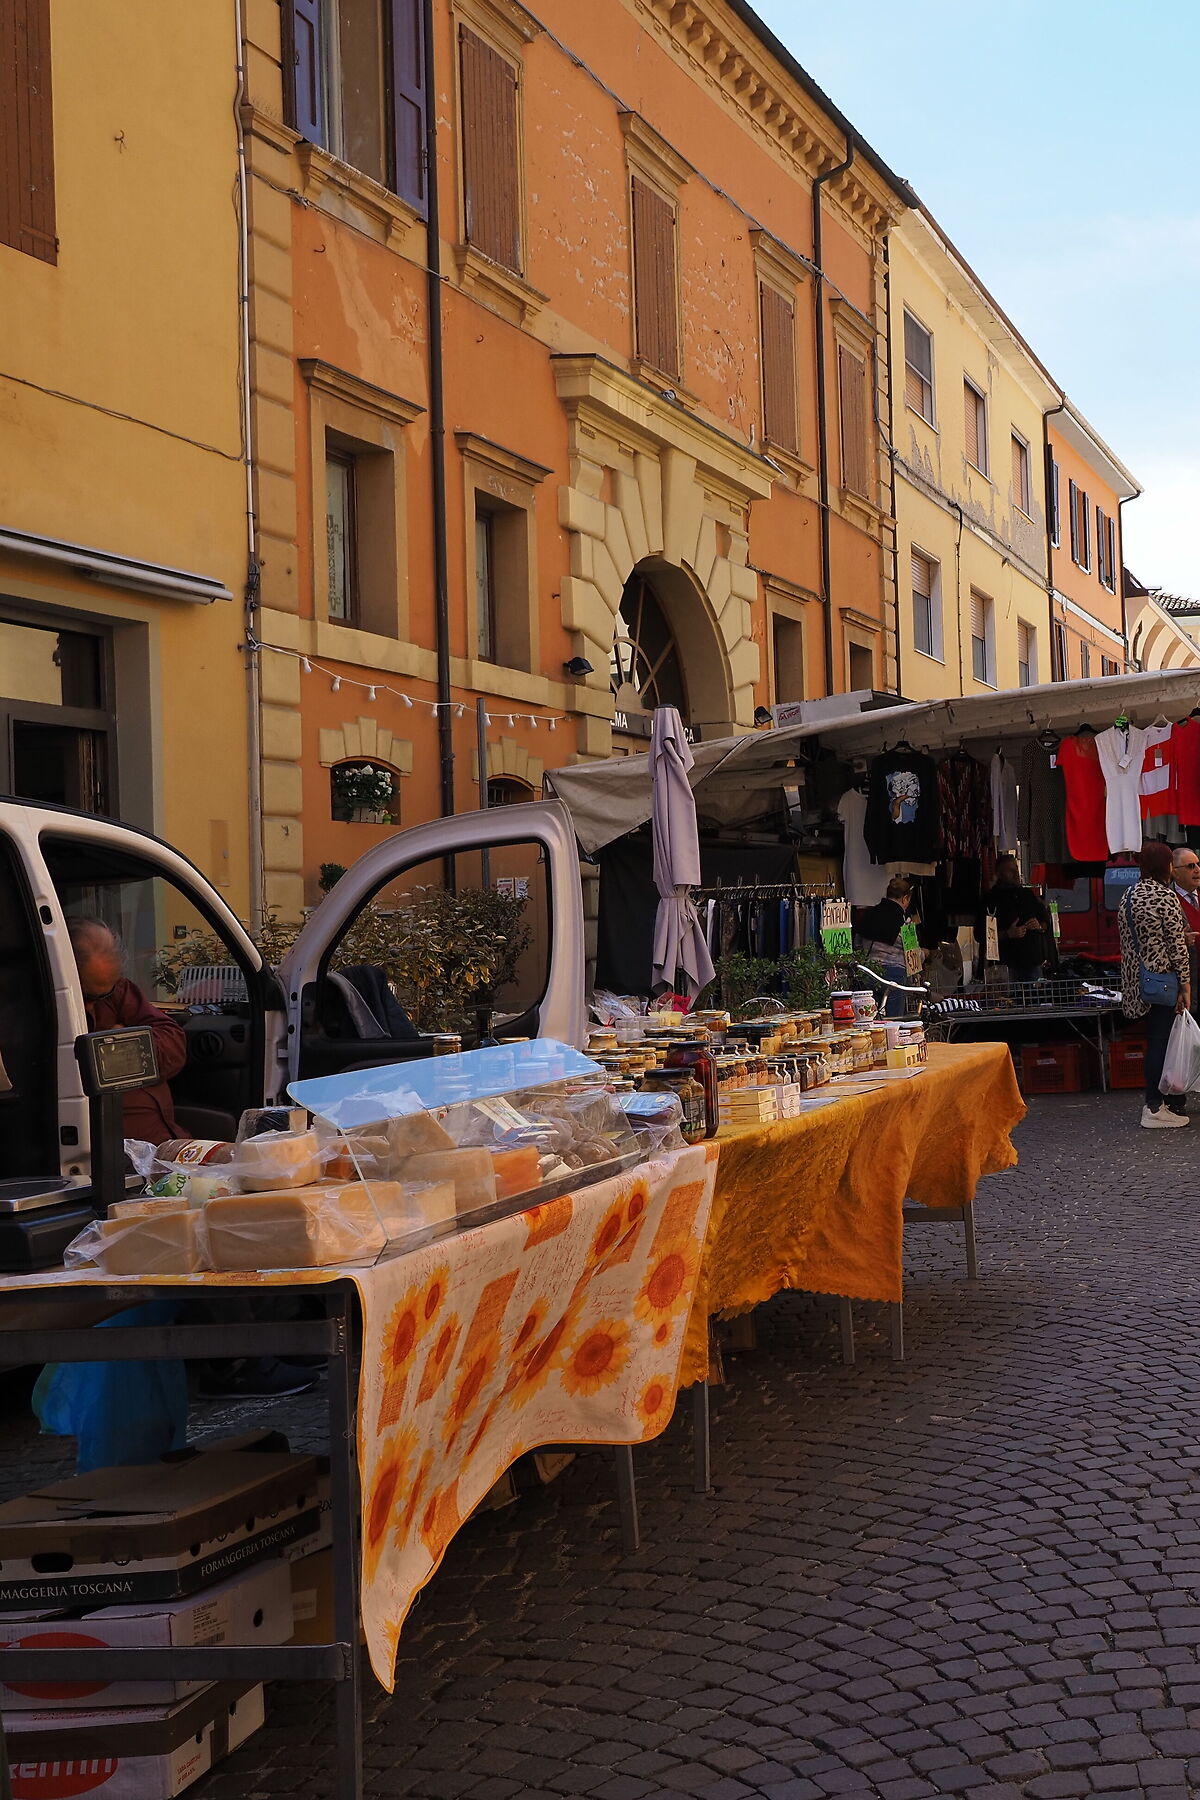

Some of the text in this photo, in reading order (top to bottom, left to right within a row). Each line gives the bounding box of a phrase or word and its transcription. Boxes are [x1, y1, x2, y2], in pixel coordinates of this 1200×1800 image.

[201, 1525, 296, 1577] FORMAGGERIA TOSCANA
[70, 1581, 133, 1596] TOSCANA
